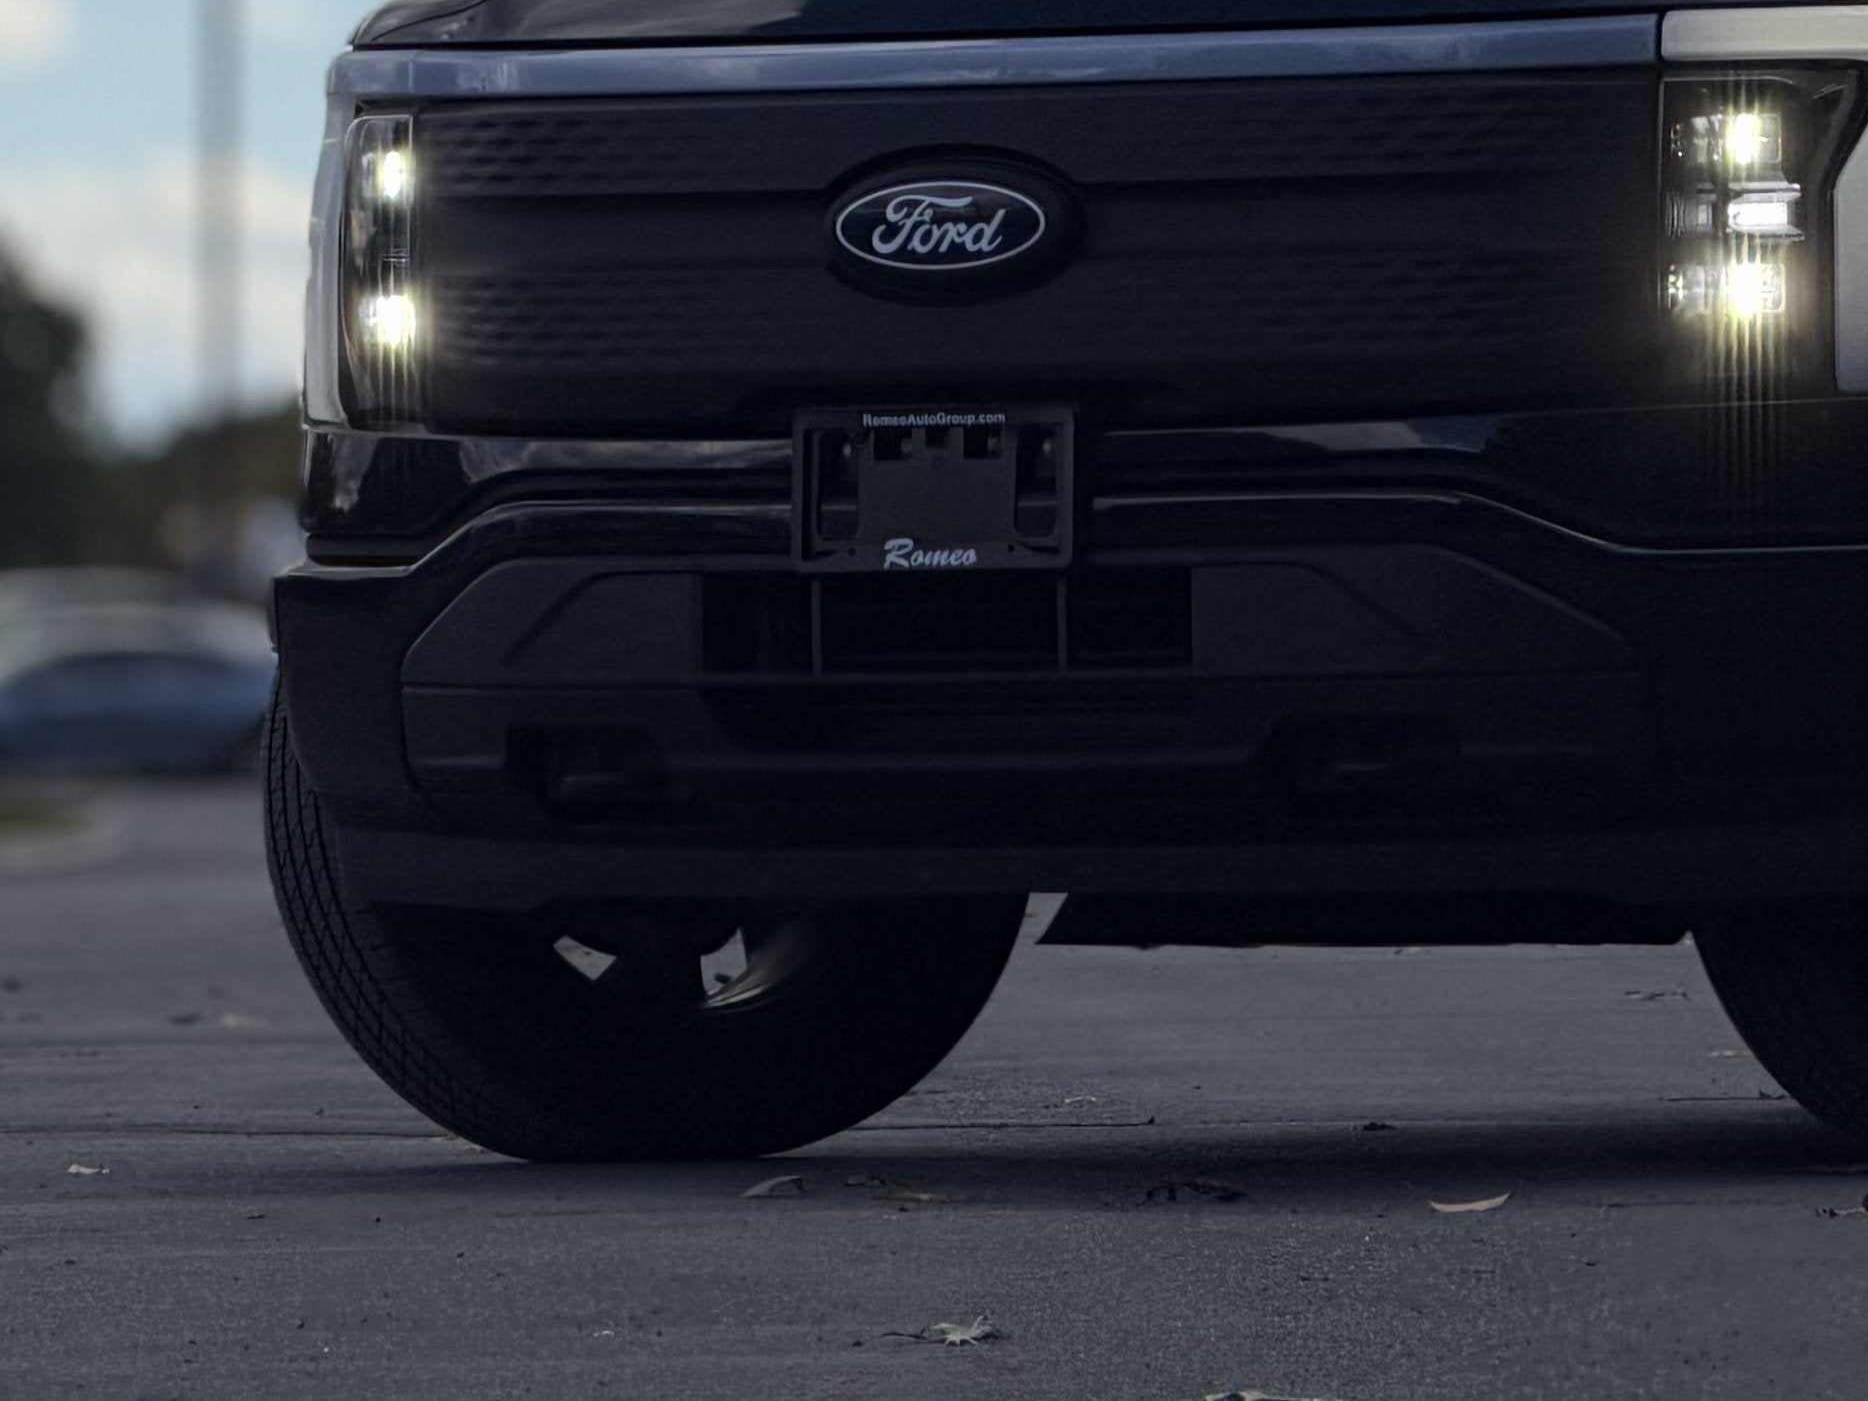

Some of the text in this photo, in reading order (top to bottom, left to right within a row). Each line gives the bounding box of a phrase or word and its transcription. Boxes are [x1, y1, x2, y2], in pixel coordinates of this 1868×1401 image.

[871, 194, 1006, 254] Ford
[862, 411, 1006, 428] RomeoAutoGroup.com
[883, 537, 978, 569] Romeo
